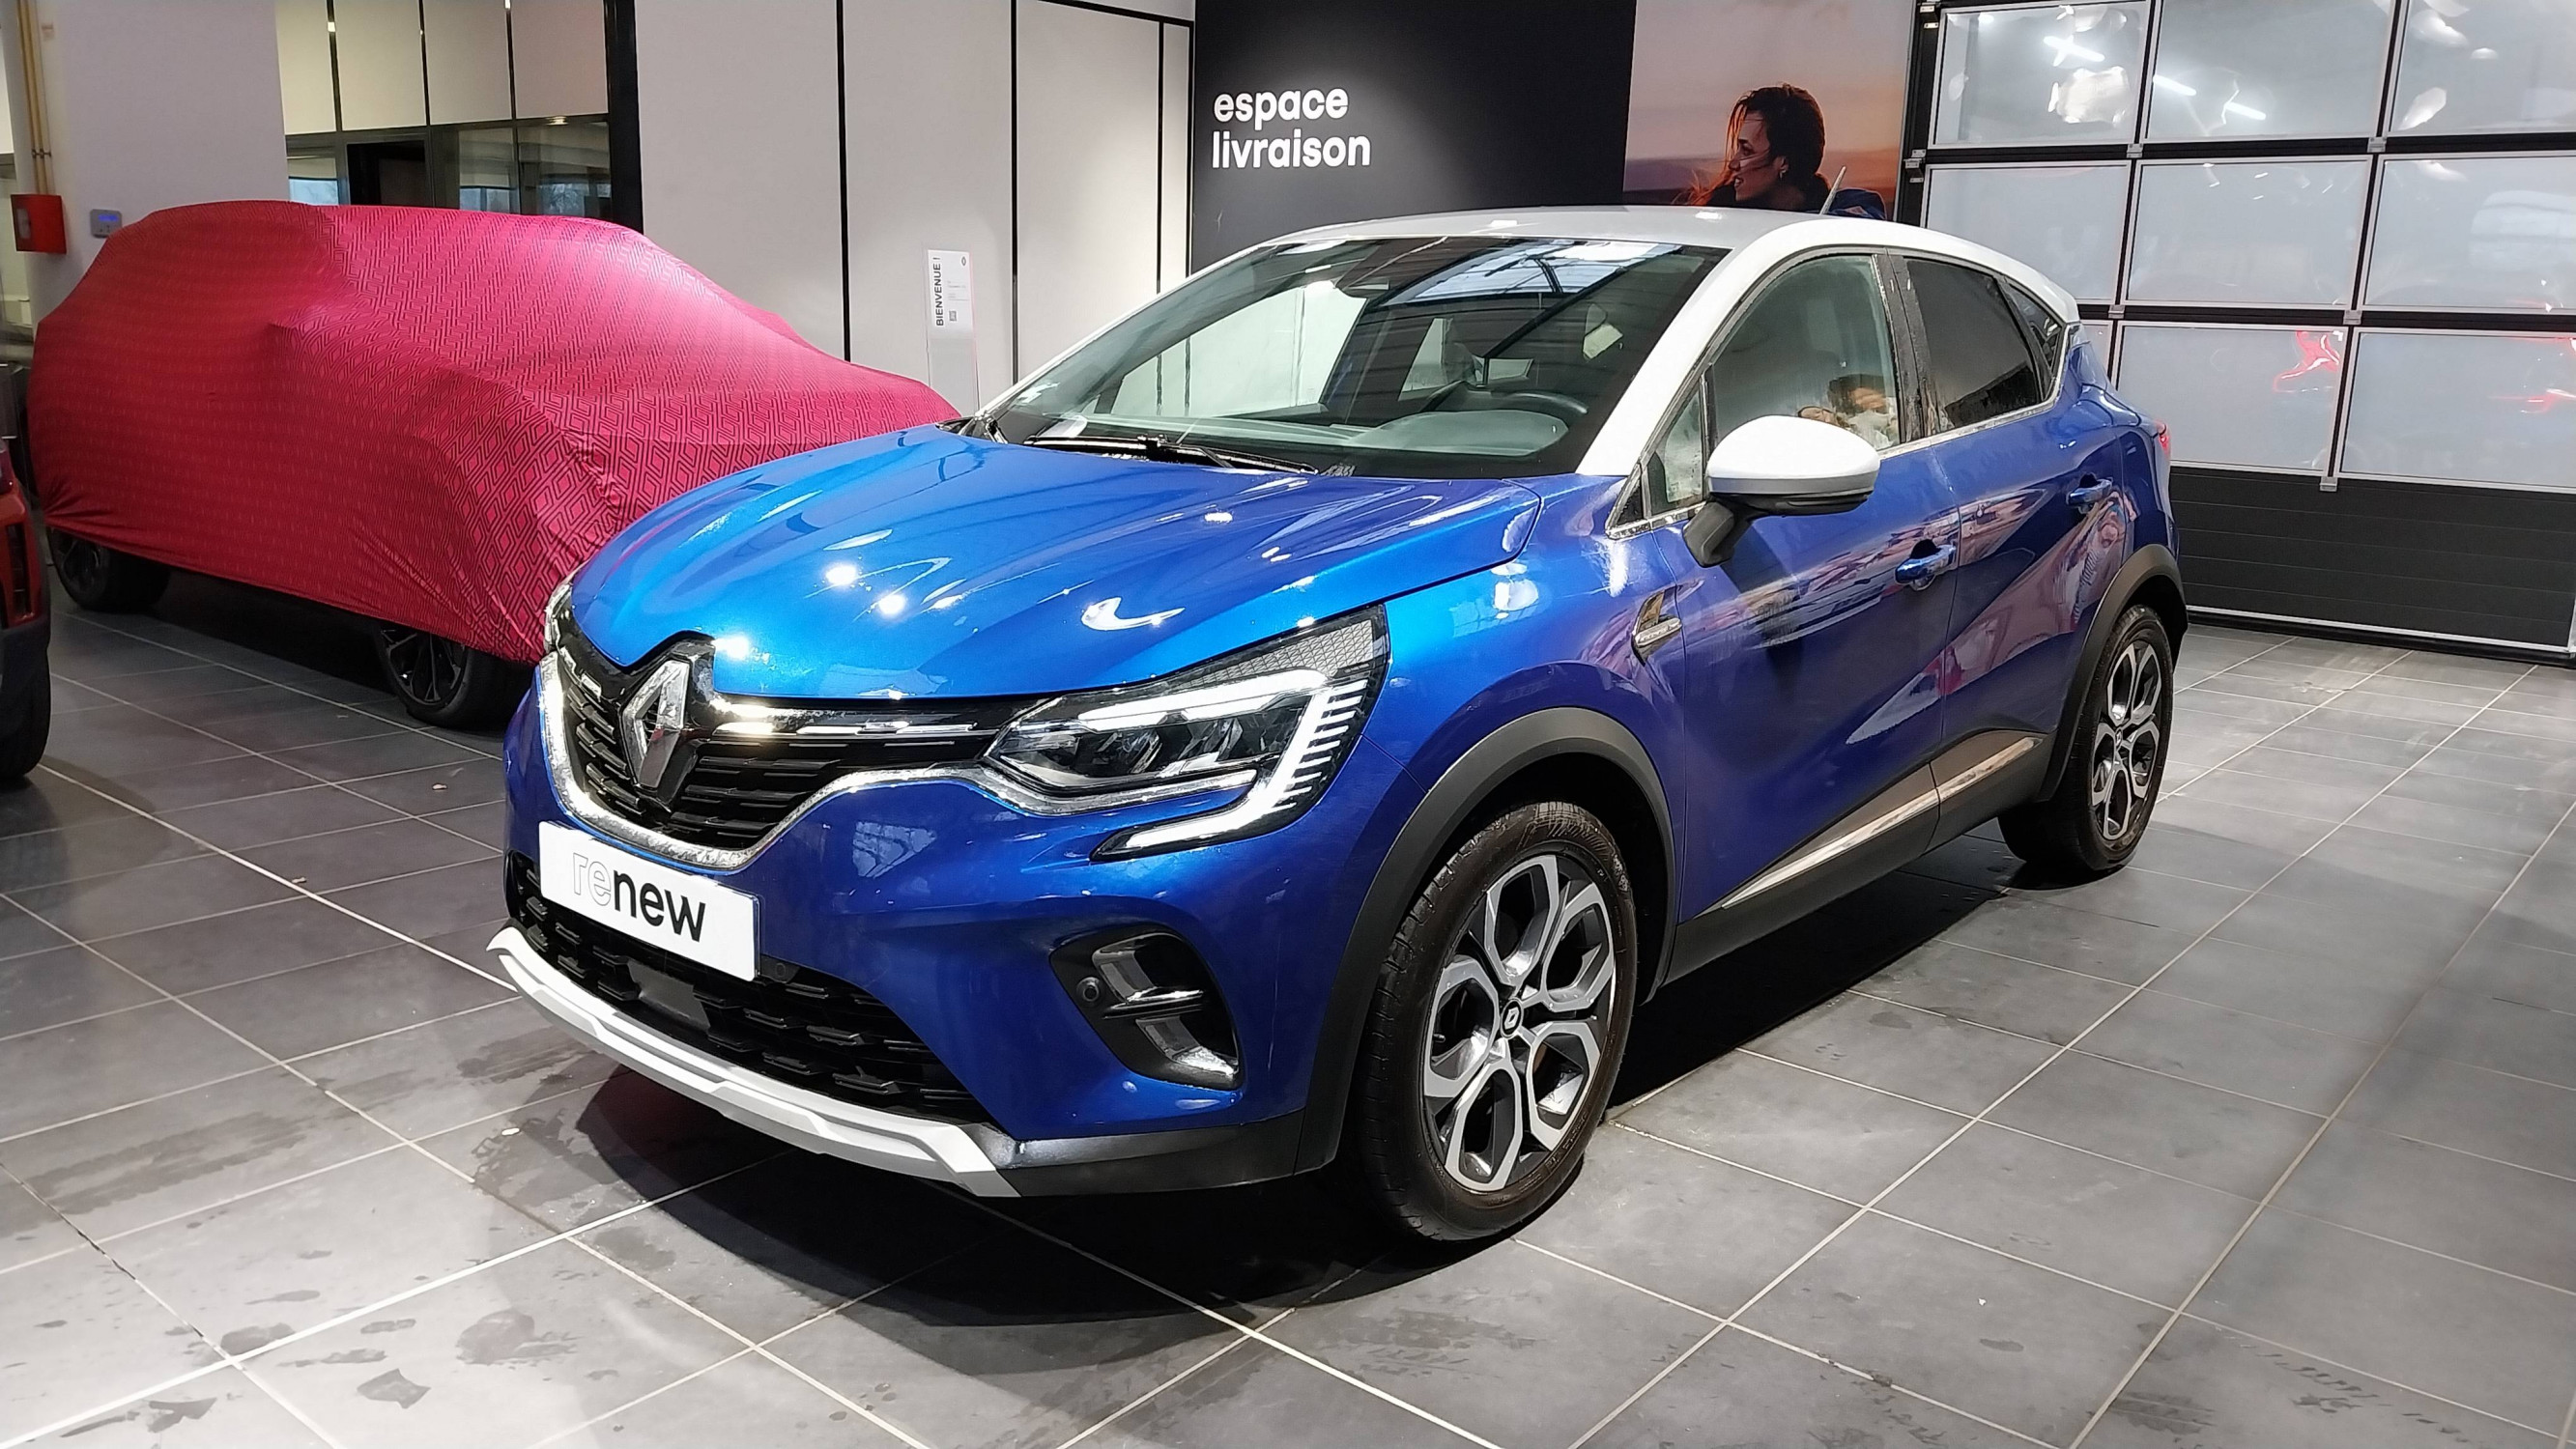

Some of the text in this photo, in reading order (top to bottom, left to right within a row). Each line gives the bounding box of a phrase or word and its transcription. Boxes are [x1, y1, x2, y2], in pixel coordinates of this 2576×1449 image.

[1214, 88, 1349, 131] espace
[1212, 128, 1371, 168] livraison
[932, 263, 944, 327] BIENVENUE
[572, 852, 706, 943] renew
